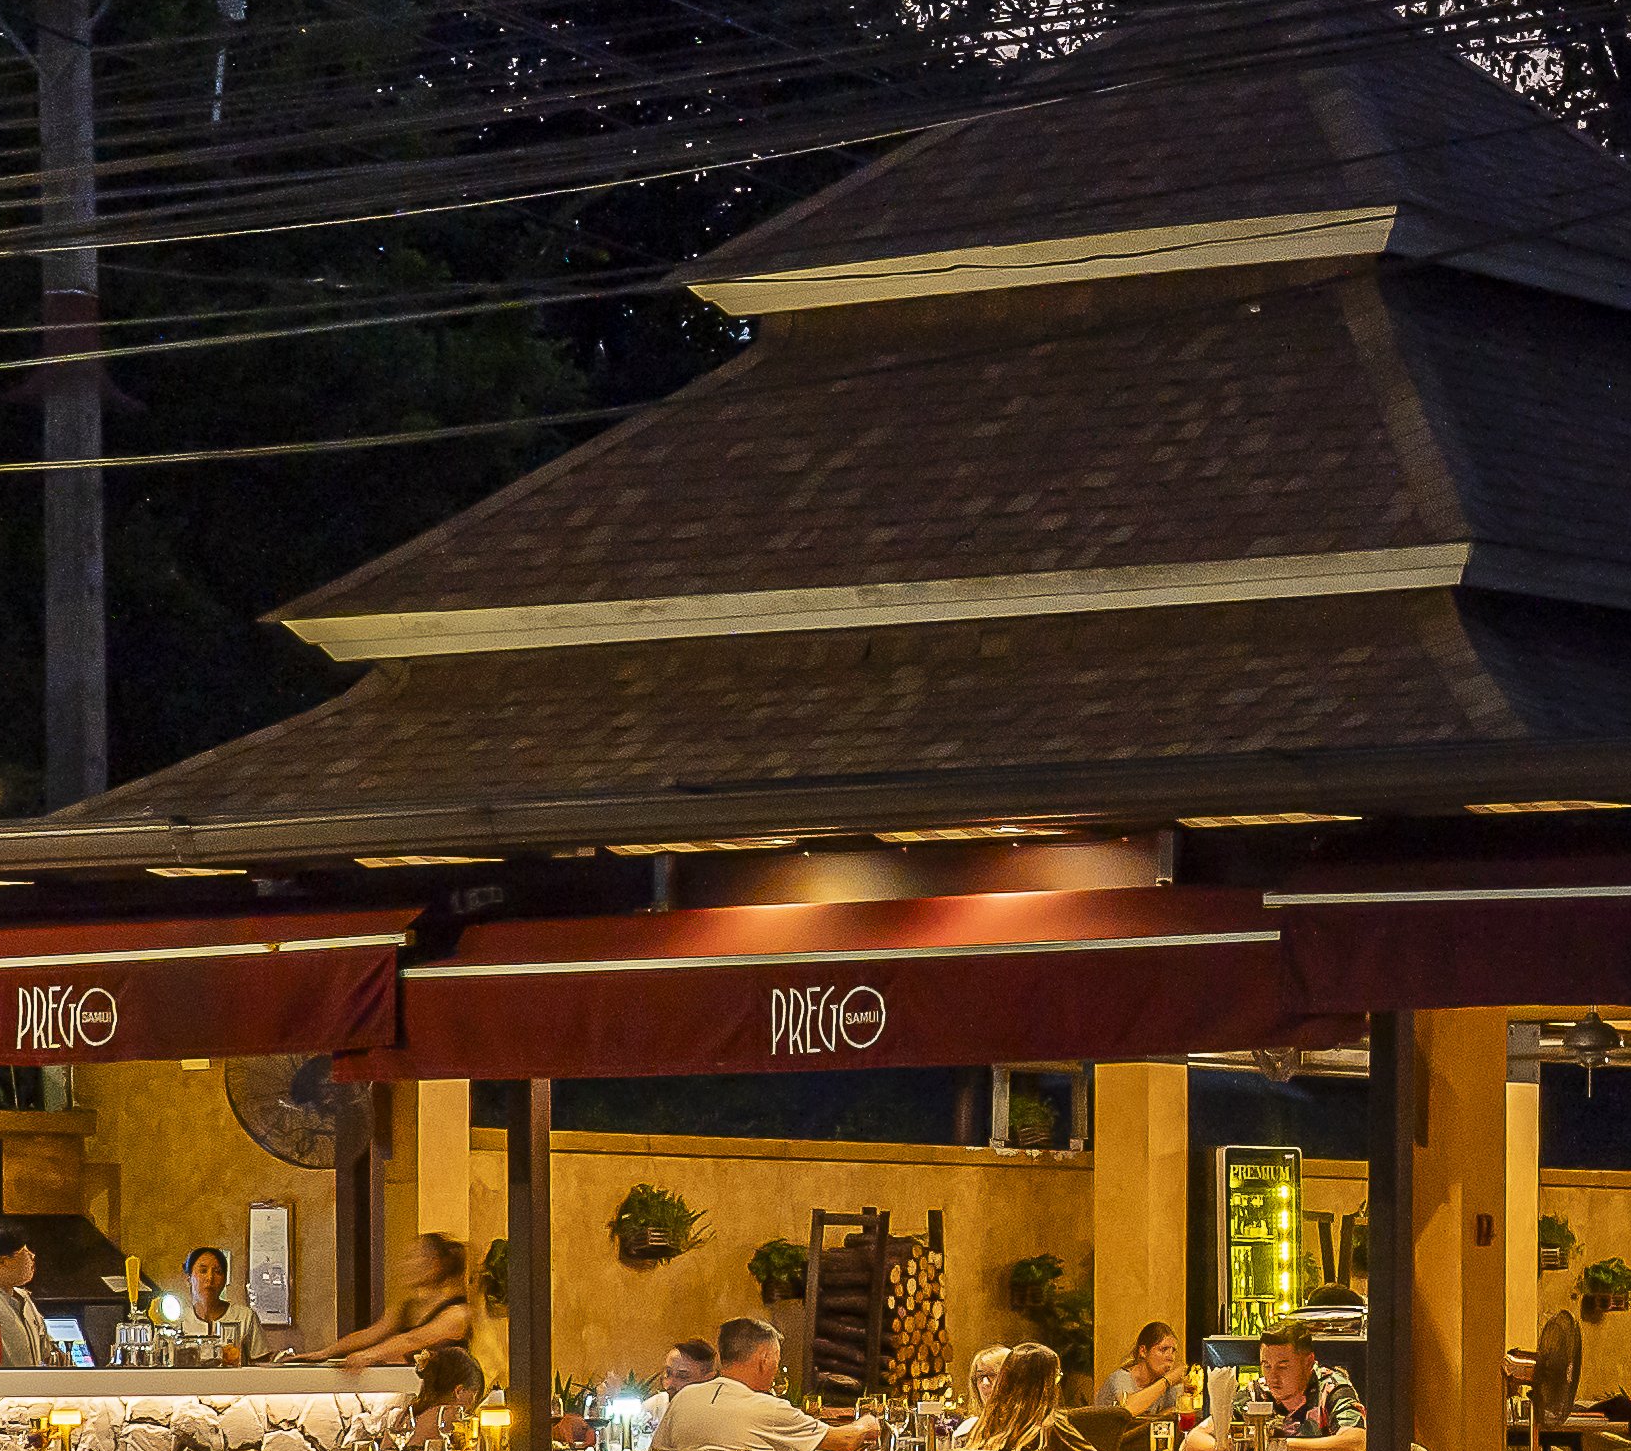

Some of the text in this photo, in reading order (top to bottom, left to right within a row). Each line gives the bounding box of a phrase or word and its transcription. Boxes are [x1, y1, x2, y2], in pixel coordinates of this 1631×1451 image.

[16, 985, 117, 1049] PREGO
[771, 985, 886, 1055] PREGO
[845, 1011, 879, 1024] SAMUI
